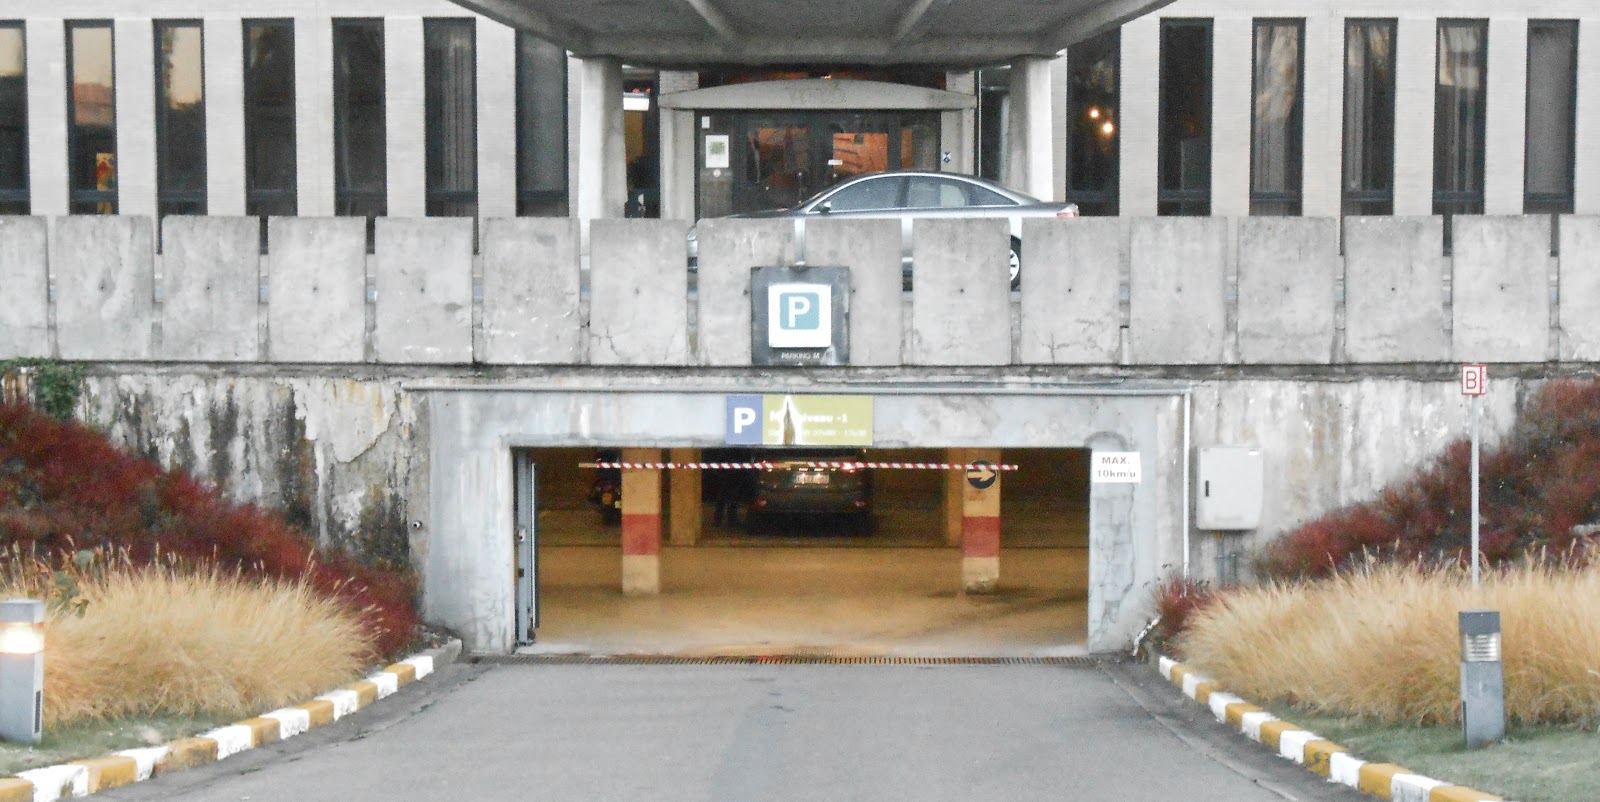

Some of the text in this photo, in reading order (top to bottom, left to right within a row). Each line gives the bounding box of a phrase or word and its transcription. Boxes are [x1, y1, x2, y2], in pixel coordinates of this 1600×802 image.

[788, 296, 811, 328] P
[781, 352, 811, 360] PARKING
[1466, 370, 1477, 389] B
[734, 407, 756, 434] P
